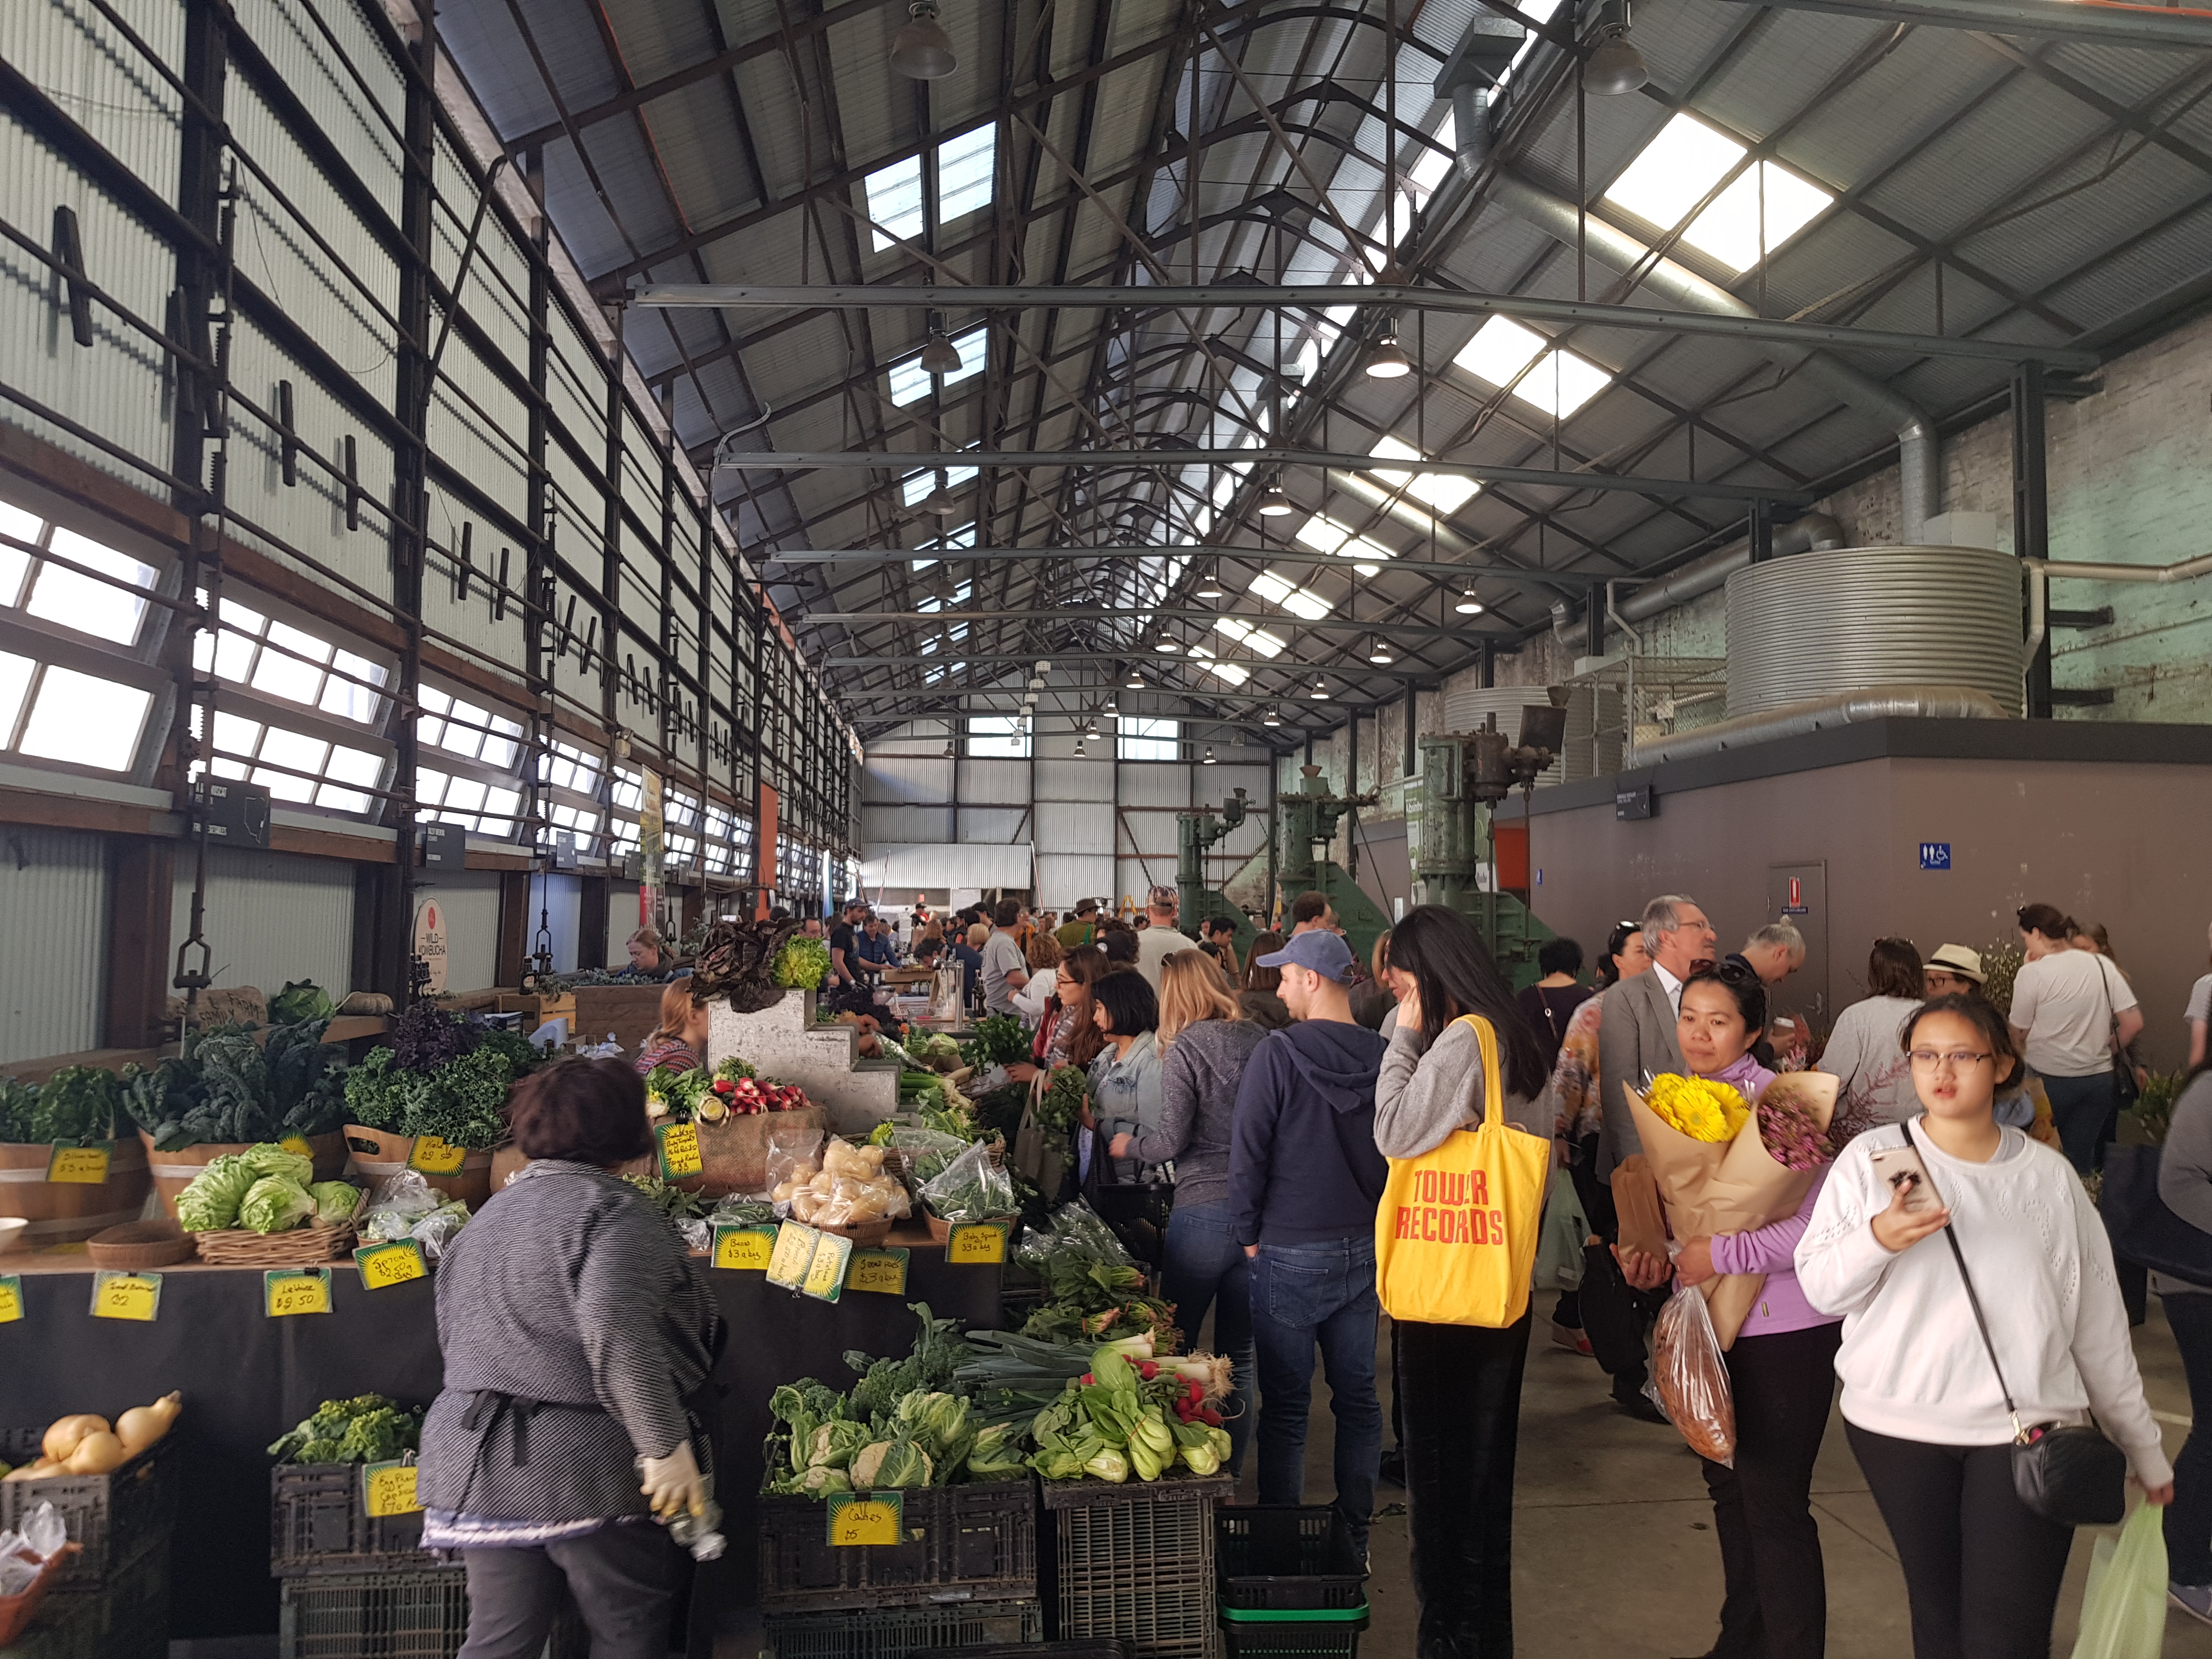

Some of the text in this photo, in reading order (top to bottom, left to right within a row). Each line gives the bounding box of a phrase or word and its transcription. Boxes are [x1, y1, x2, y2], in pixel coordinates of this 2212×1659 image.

[426, 933, 438, 944] WILD
[418, 945, 446, 956] KOMBUCHA
[1395, 1206, 1504, 1245] RECORDS
[963, 1232, 980, 1243] Baby
